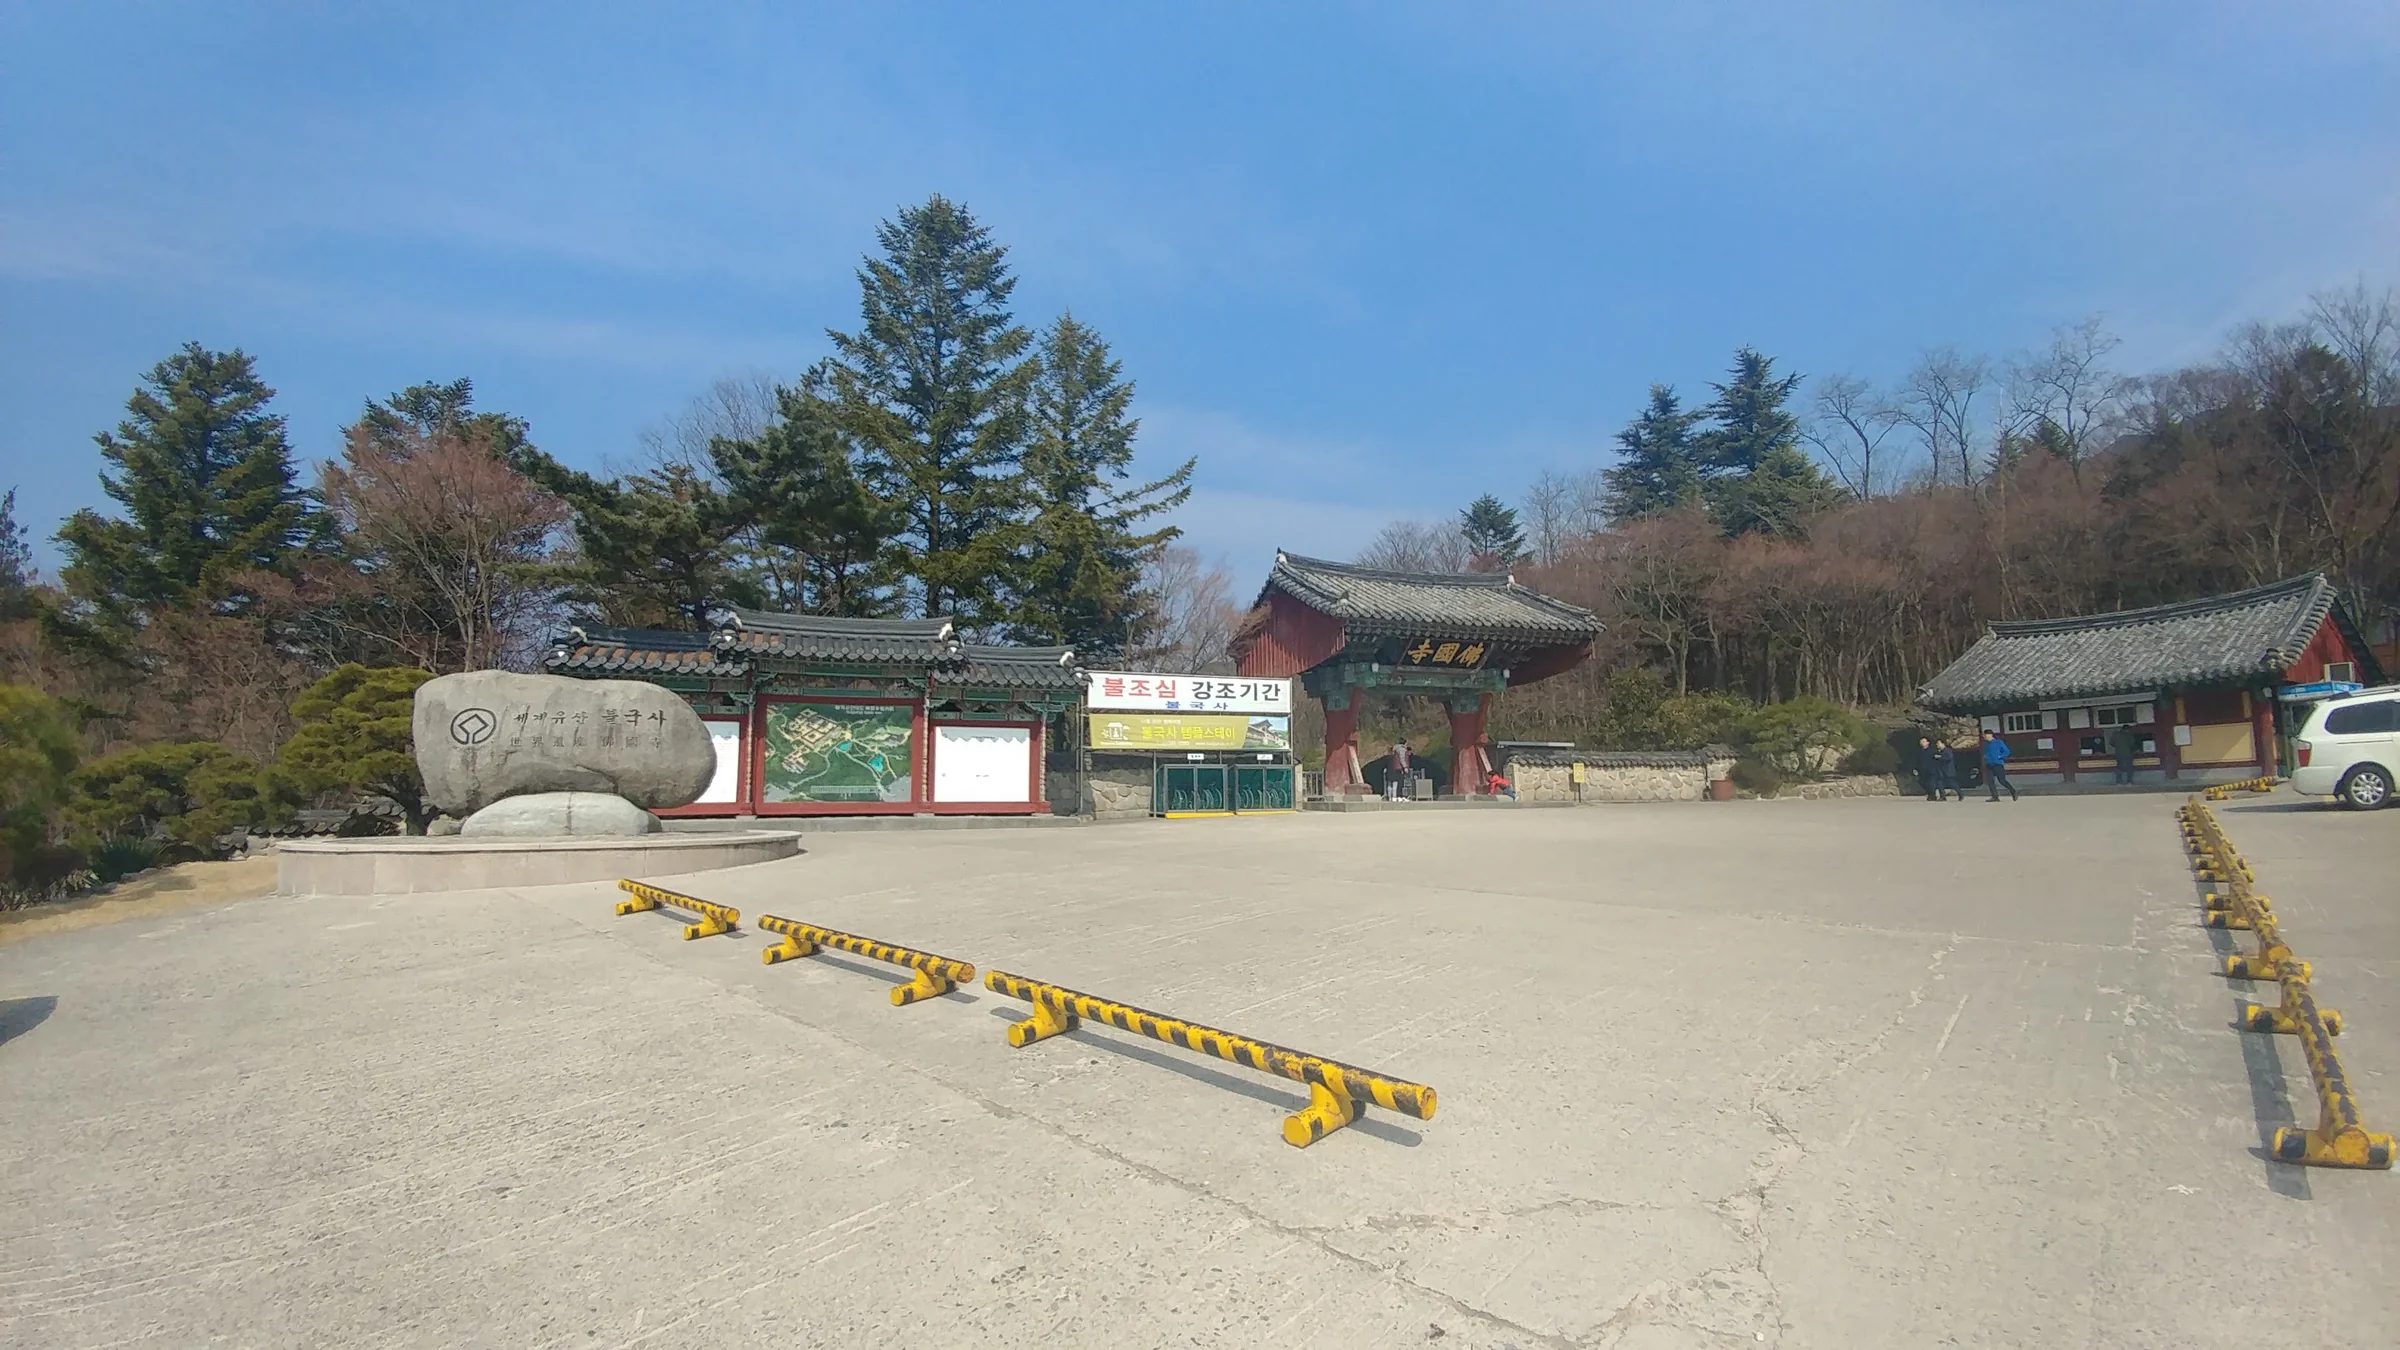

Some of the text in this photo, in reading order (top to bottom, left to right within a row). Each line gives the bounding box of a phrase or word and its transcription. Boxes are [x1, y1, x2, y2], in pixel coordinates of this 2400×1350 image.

[1101, 677, 1281, 702] 불조심 강조기간
[513, 708, 668, 728] 세계유산 불국사
[1141, 725, 1236, 740] 불국사 템플스테이
